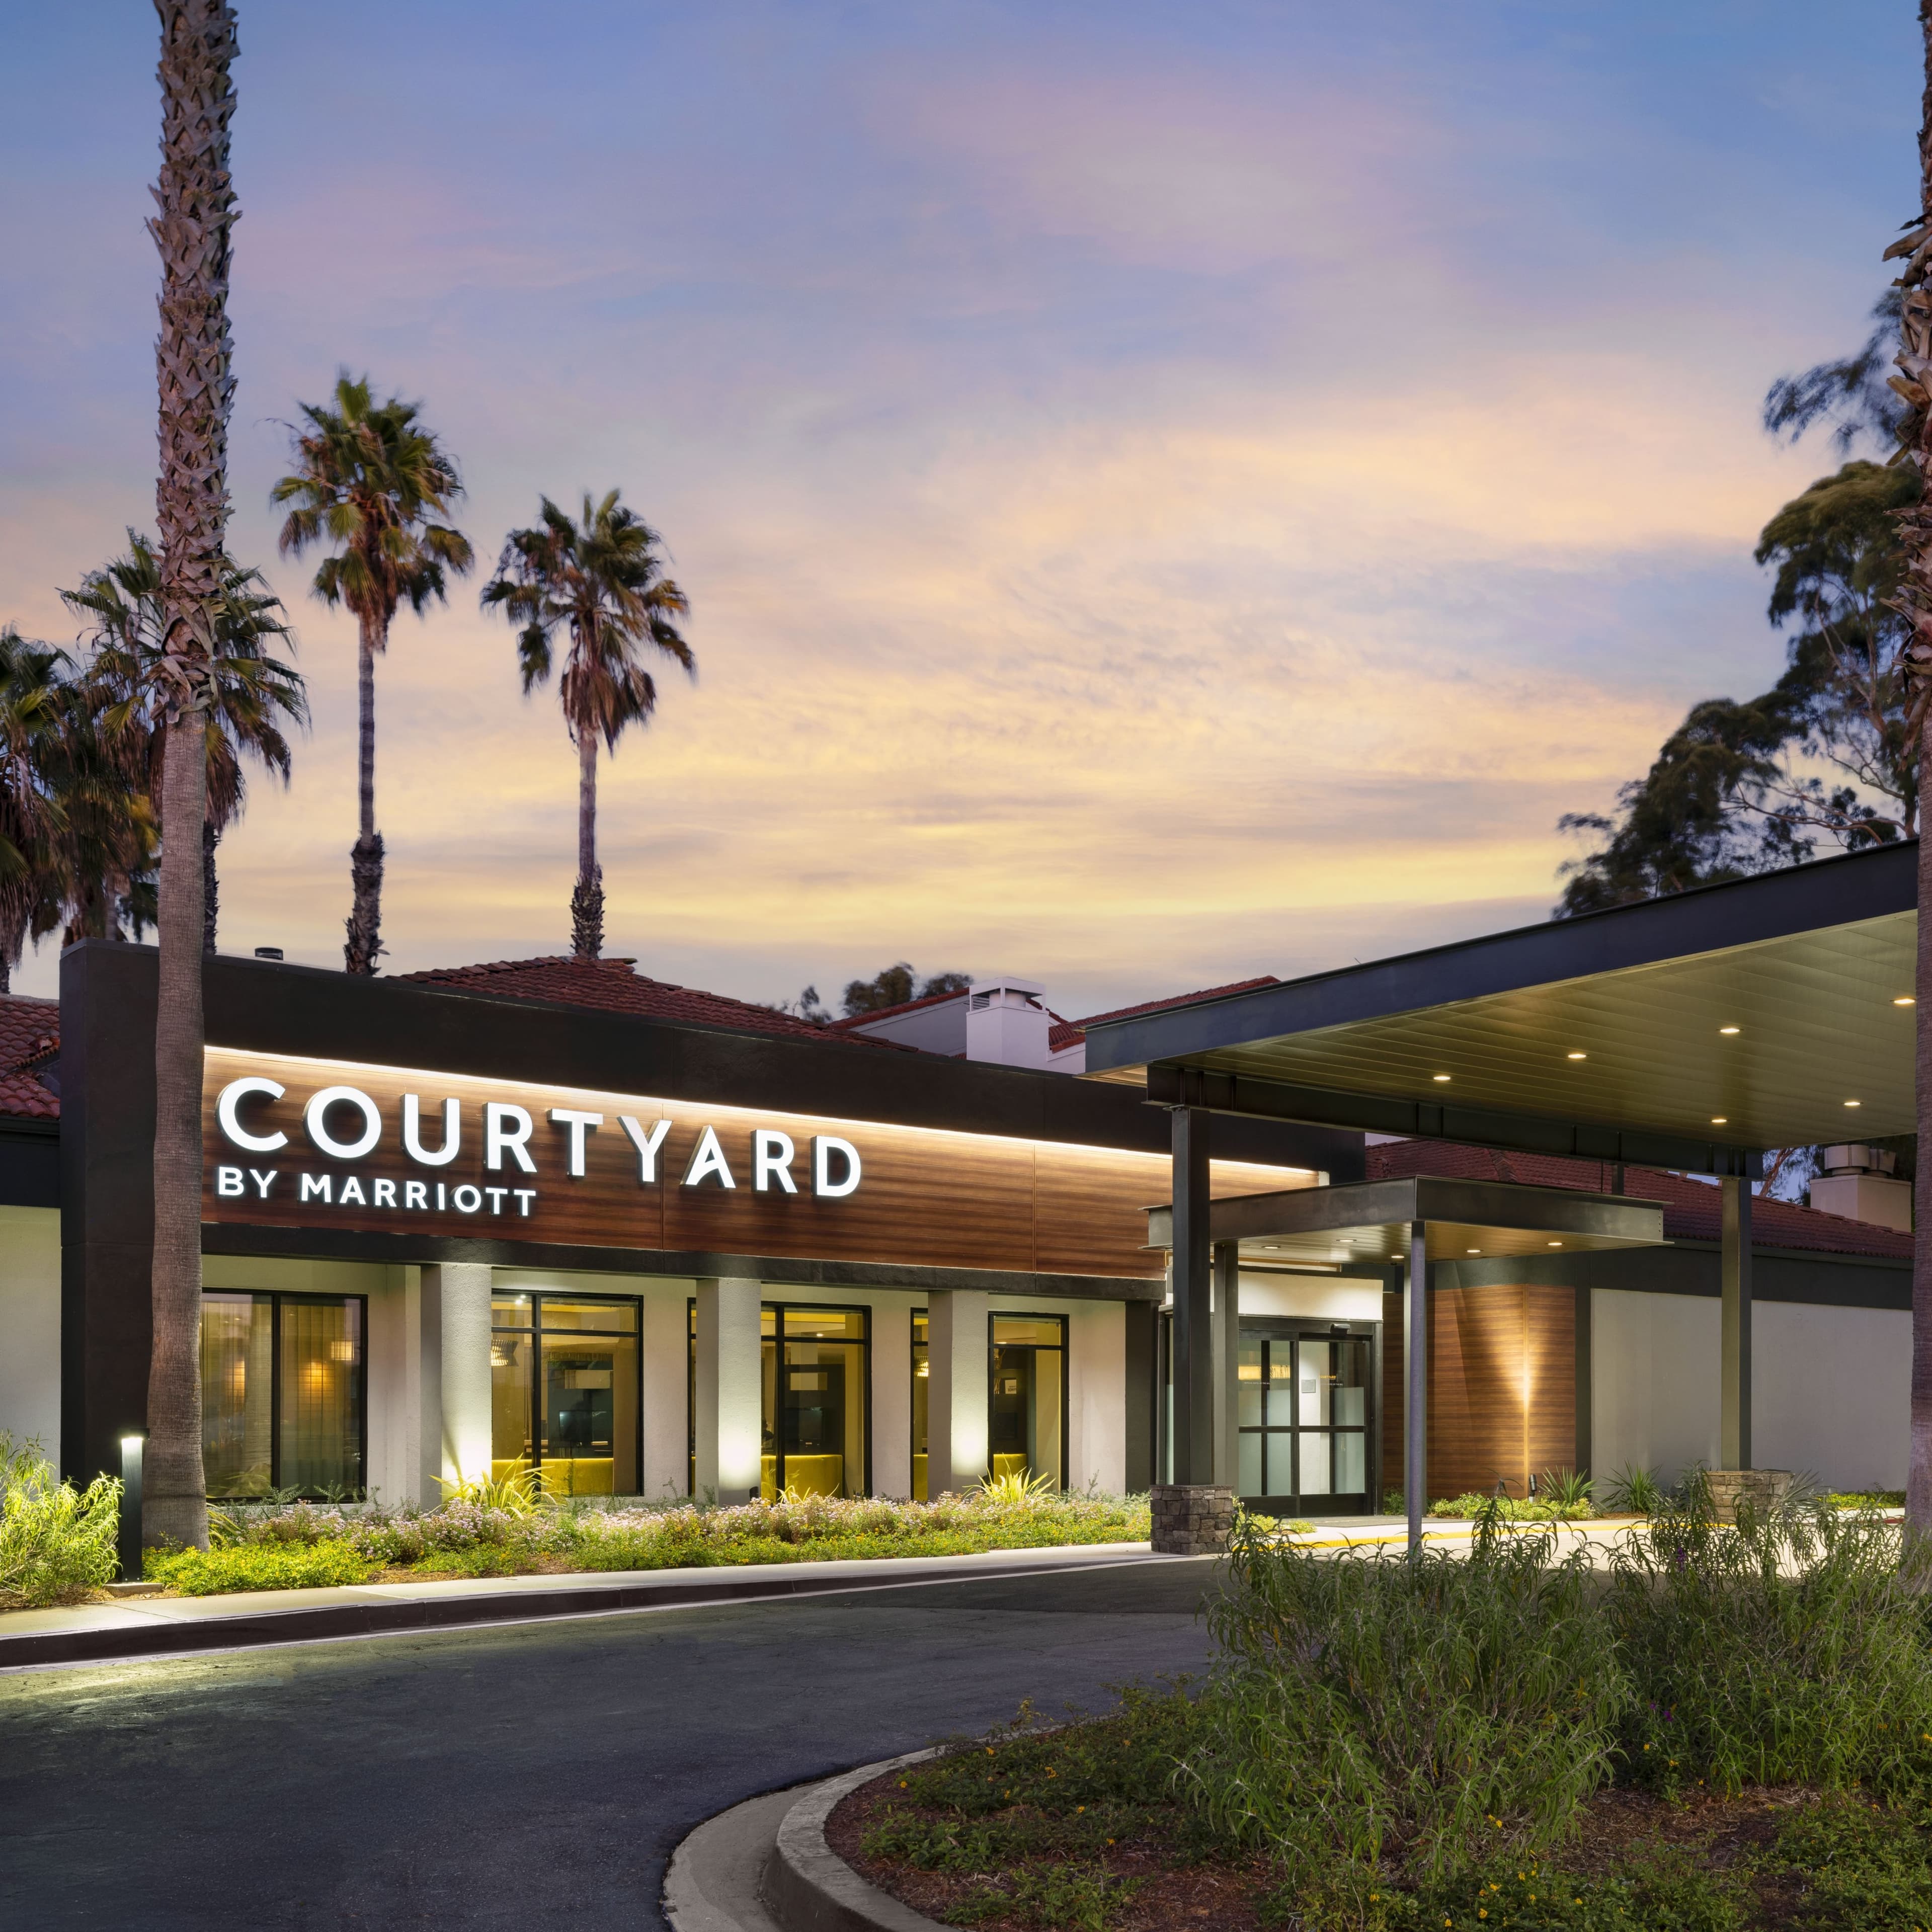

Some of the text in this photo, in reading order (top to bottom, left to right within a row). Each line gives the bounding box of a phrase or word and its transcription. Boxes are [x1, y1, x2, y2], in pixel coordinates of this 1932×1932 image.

[217, 1077, 861, 1197] COURTYARD
[218, 1166, 537, 1217] BY MARRIOTT
